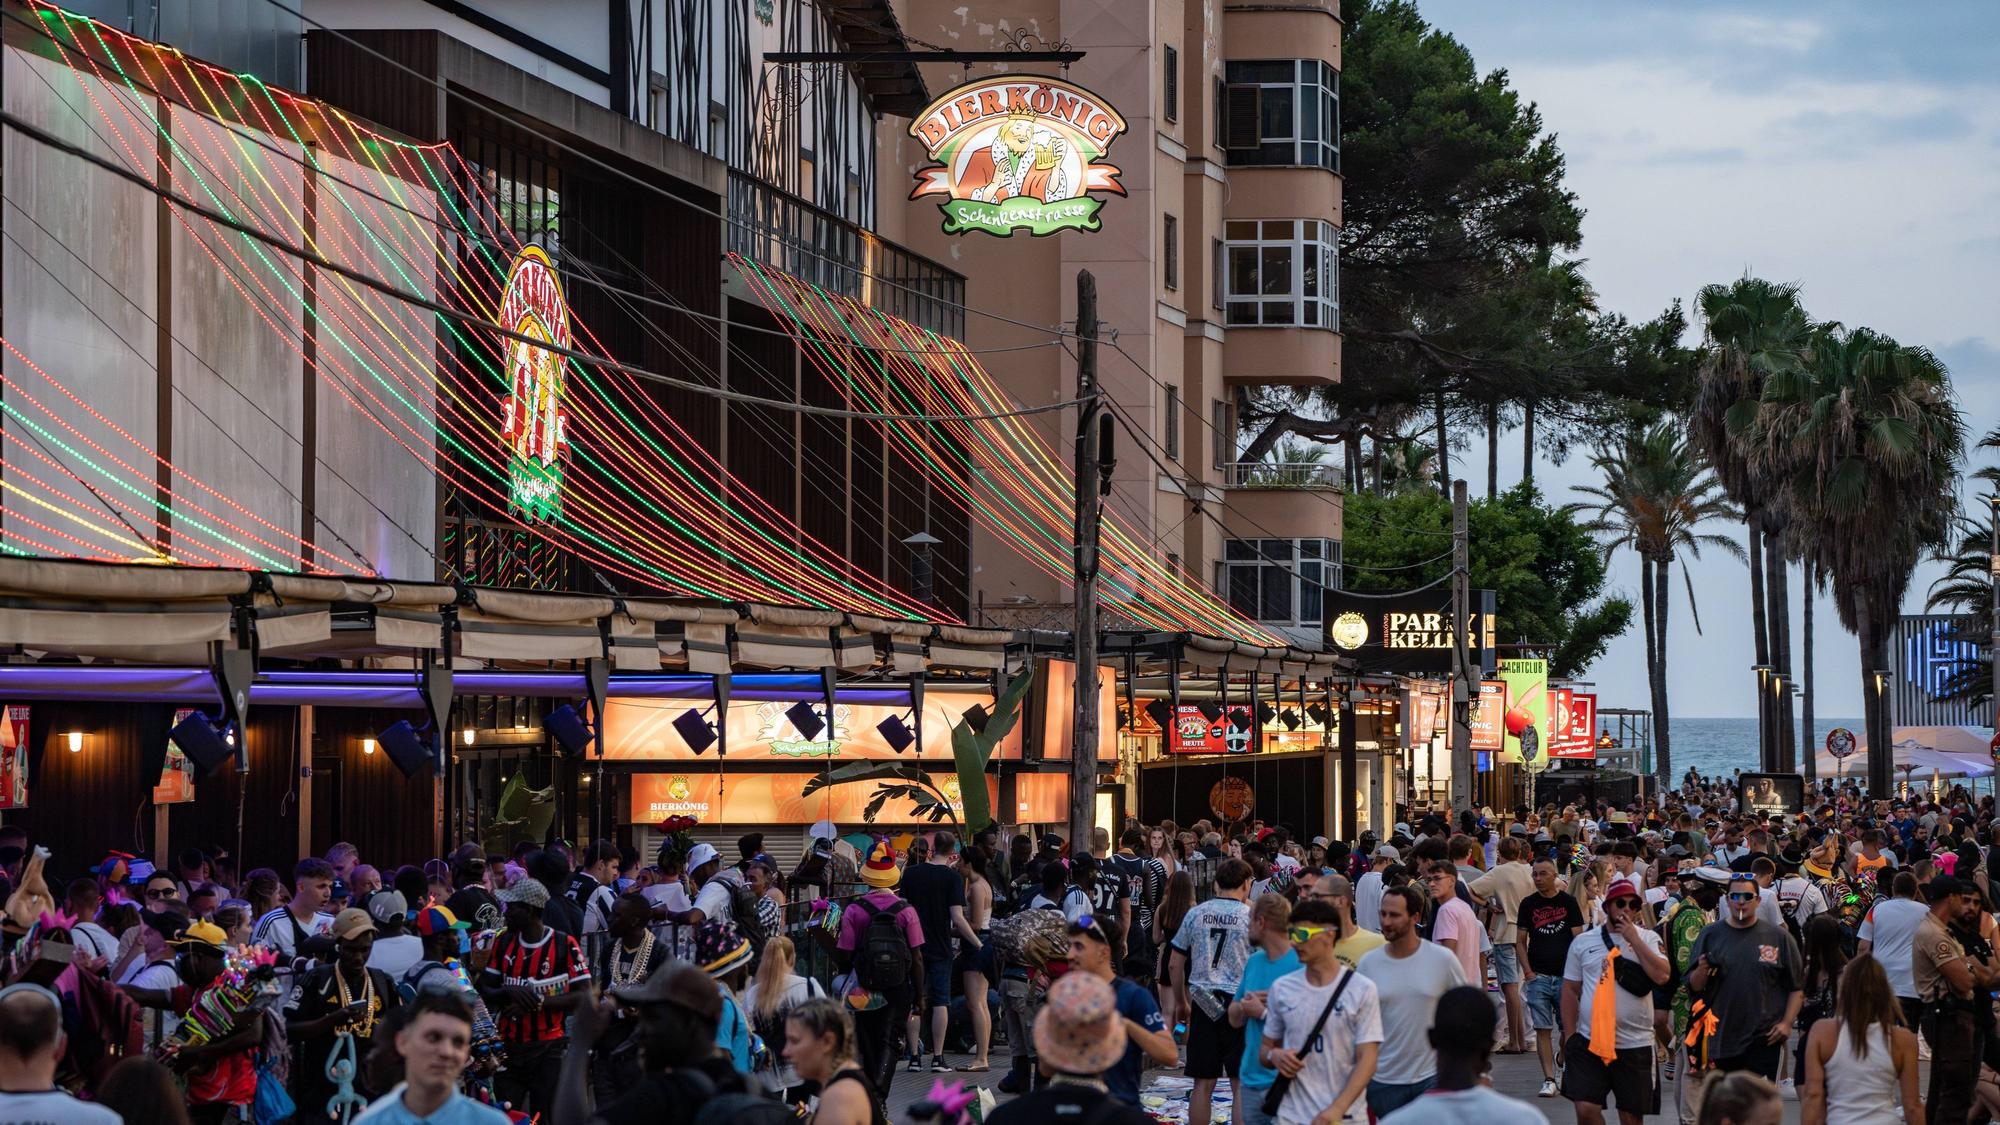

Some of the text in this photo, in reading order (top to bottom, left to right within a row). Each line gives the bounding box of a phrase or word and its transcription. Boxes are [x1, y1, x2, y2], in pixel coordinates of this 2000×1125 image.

[920, 84, 1114, 146] BIERKÖNIG
[958, 203, 1087, 228] Schinkenstrasse
[650, 801, 709, 811] BIERKÖNIG
[1094, 882, 1119, 910] 97
[1203, 914, 1239, 926] RONALDO
[1209, 927, 1228, 968] 7
